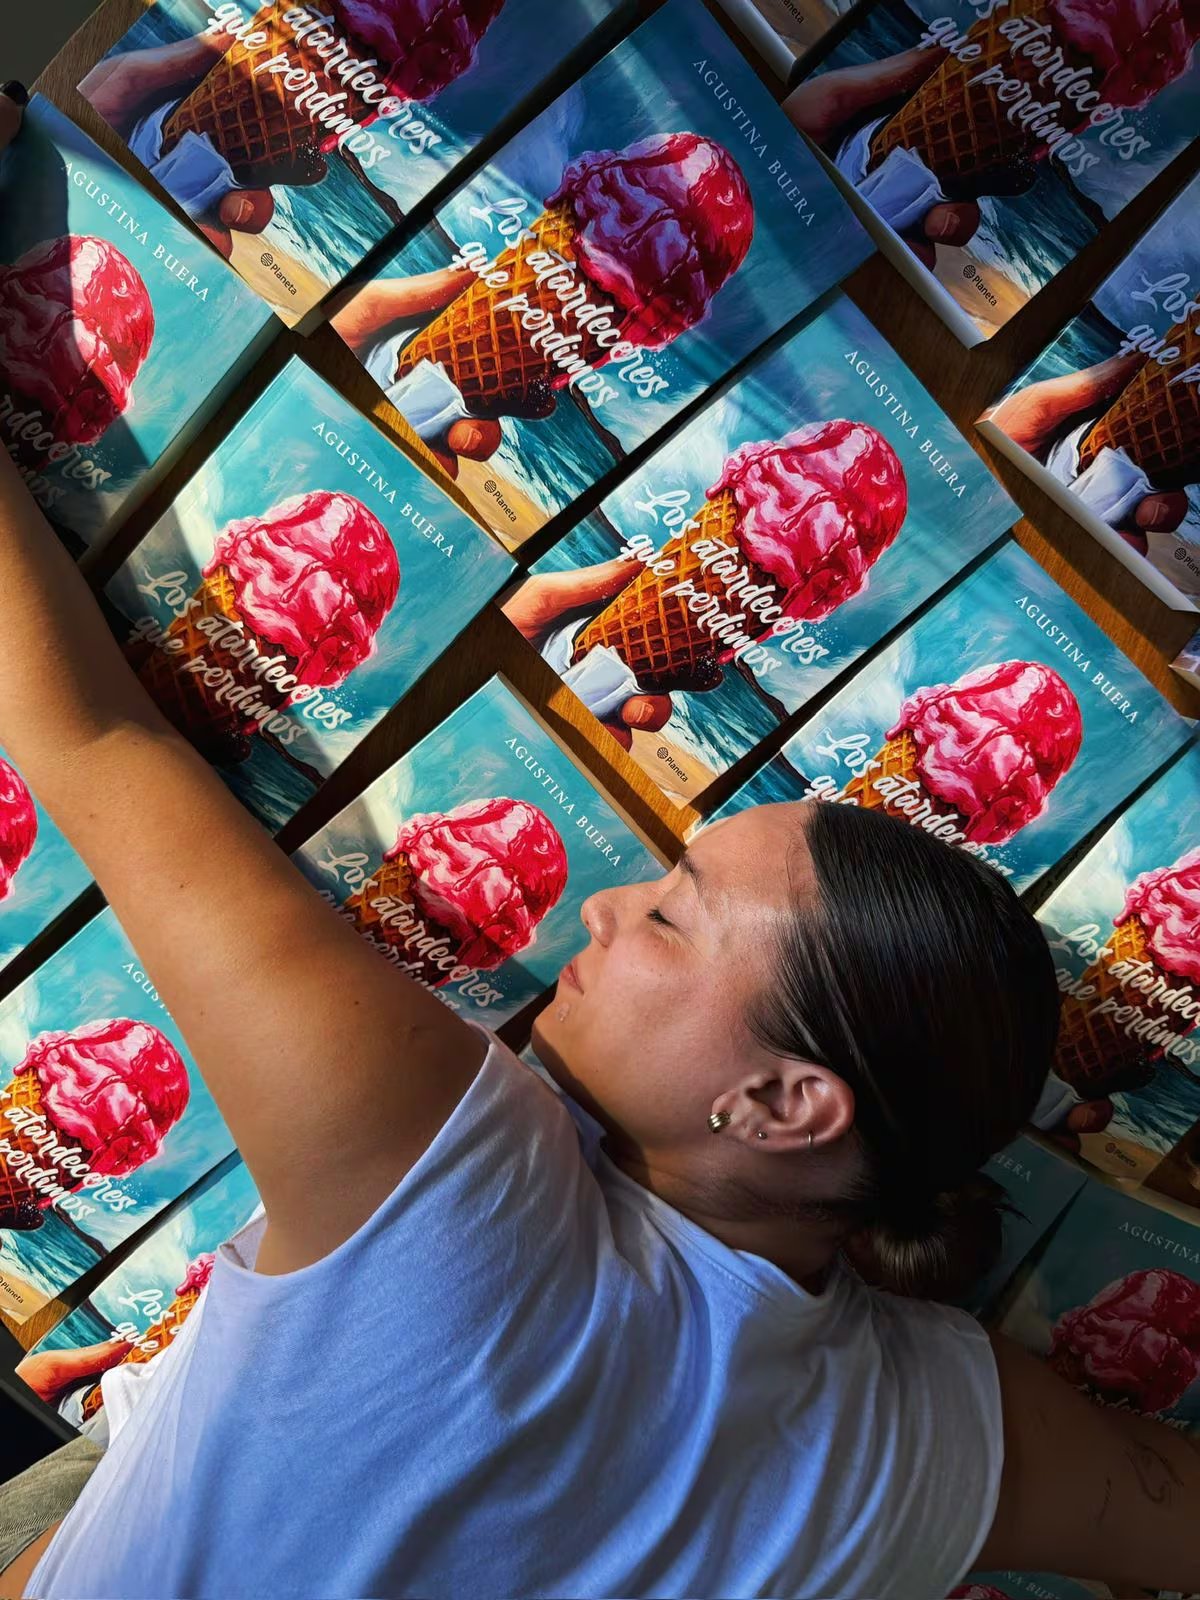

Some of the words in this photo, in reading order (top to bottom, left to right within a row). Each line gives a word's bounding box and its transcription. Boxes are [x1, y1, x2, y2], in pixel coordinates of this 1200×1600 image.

[204, 3, 268, 49] que
[253, 52, 391, 169] perdimos
[916, 17, 982, 63] que
[967, 64, 1100, 177] perdimos
[693, 60, 768, 158] AGUSTINA
[768, 160, 816, 227] BUERA
[62, 161, 150, 245] AGUSTINA
[153, 244, 209, 302] BUERA
[470, 187, 536, 249] Los
[271, 264, 297, 295] Planeta
[972, 275, 998, 306] Planeta
[448, 241, 508, 288] que
[493, 293, 619, 408] perdimos
[1118, 324, 1180, 365] que
[844, 351, 919, 439] AGUSTINA
[920, 439, 967, 498] BUERA
[312, 422, 397, 504] AGUSTINA
[400, 503, 455, 558] BUERA
[492, 490, 517, 522] Planeta
[635, 482, 700, 539] Los
[138, 564, 201, 618] Los
[618, 534, 675, 577] que
[660, 579, 782, 676] perdimos
[129, 616, 184, 655] que
[179, 655, 307, 745] perdimos
[1014, 596, 1091, 672] AGUSTINA
[1091, 672, 1139, 724] BUERA
[665, 757, 689, 782] Planeta
[815, 727, 881, 778] Los
[504, 738, 576, 815] AGUSTINA
[576, 815, 621, 867] BUERA
[317, 846, 378, 895] Los
[1048, 923, 1113, 966] Los
[1108, 956, 1200, 1027] atardec
[1, 1281, 24, 1304] Planeta
[118, 1284, 175, 1325] Los
[110, 1321, 159, 1353] que
